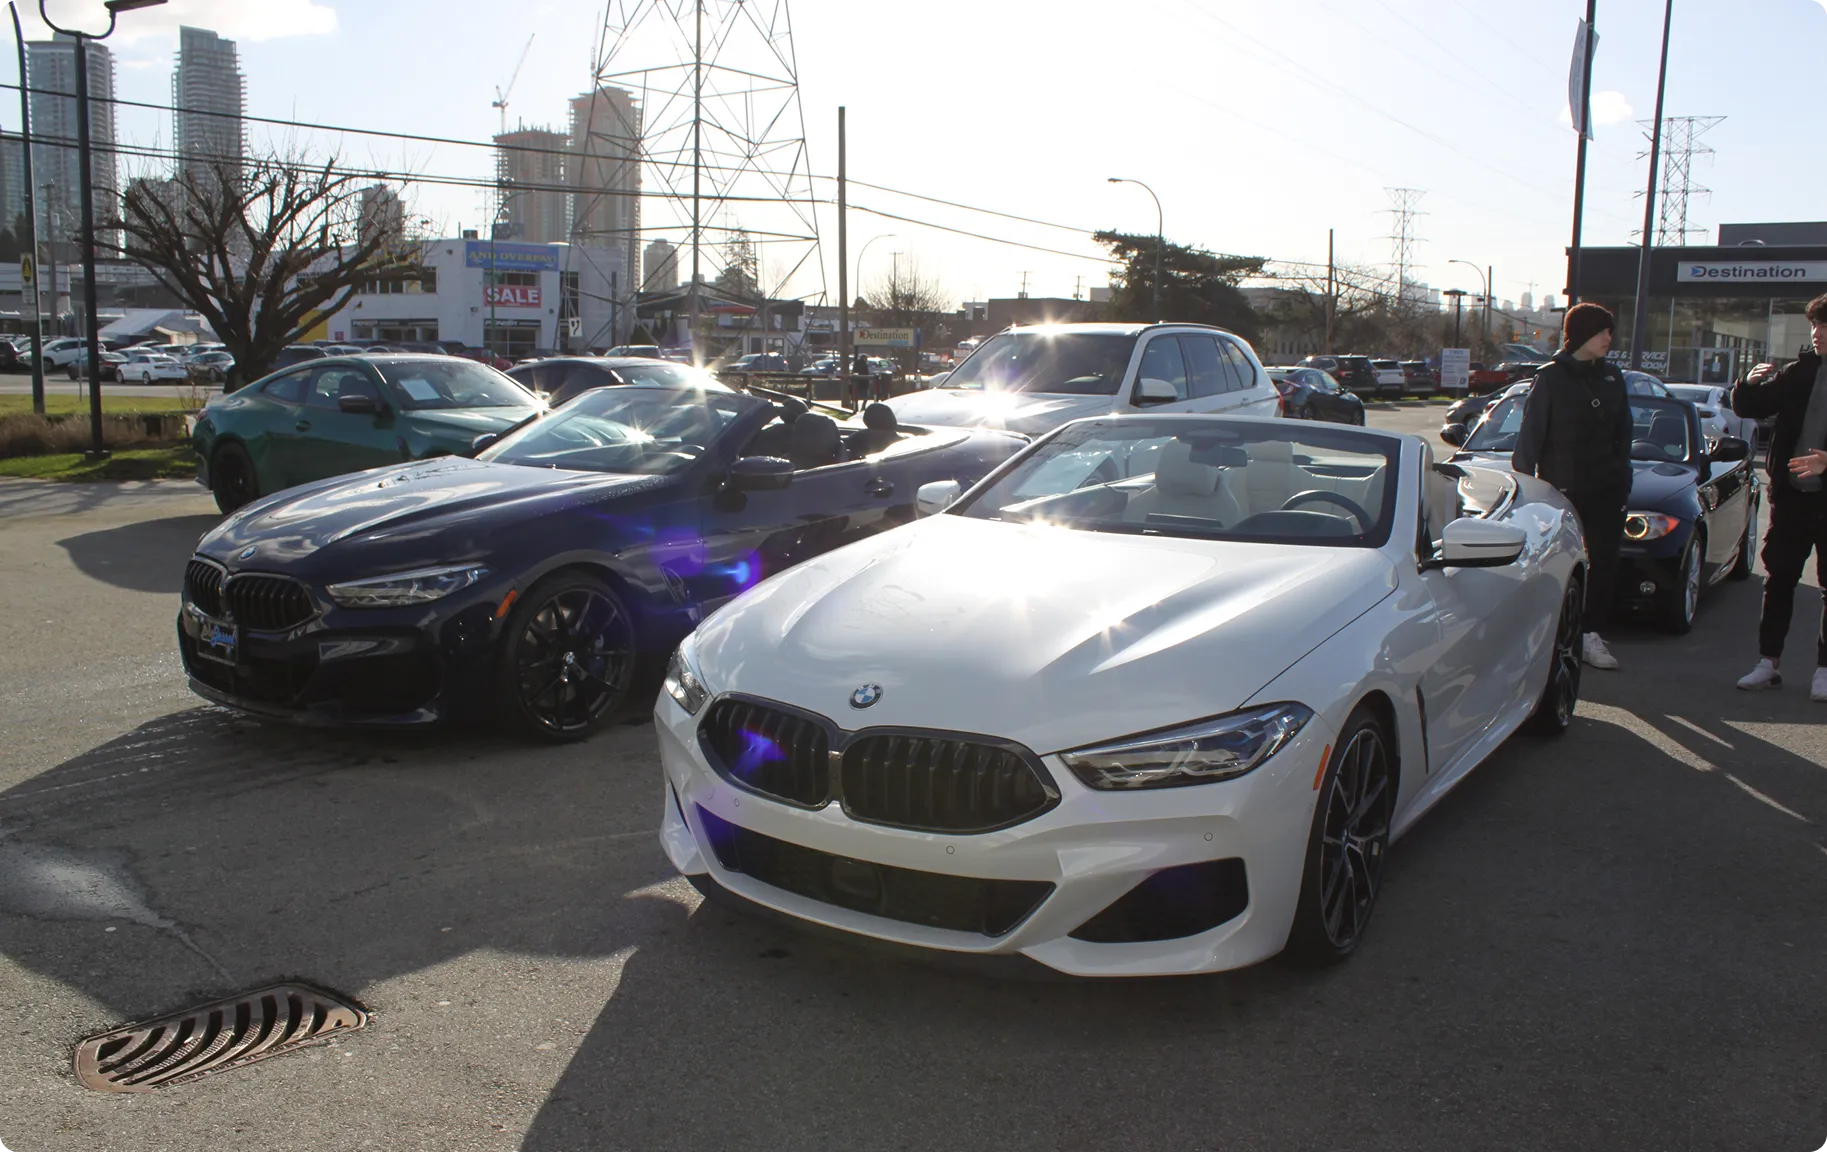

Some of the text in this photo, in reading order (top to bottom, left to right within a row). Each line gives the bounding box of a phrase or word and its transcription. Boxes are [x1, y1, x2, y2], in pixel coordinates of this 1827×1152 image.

[469, 250, 557, 263] AND OVERPAY!
[1691, 265, 1807, 278] Destination
[486, 287, 539, 303] SALE
[860, 329, 909, 339] Destination
